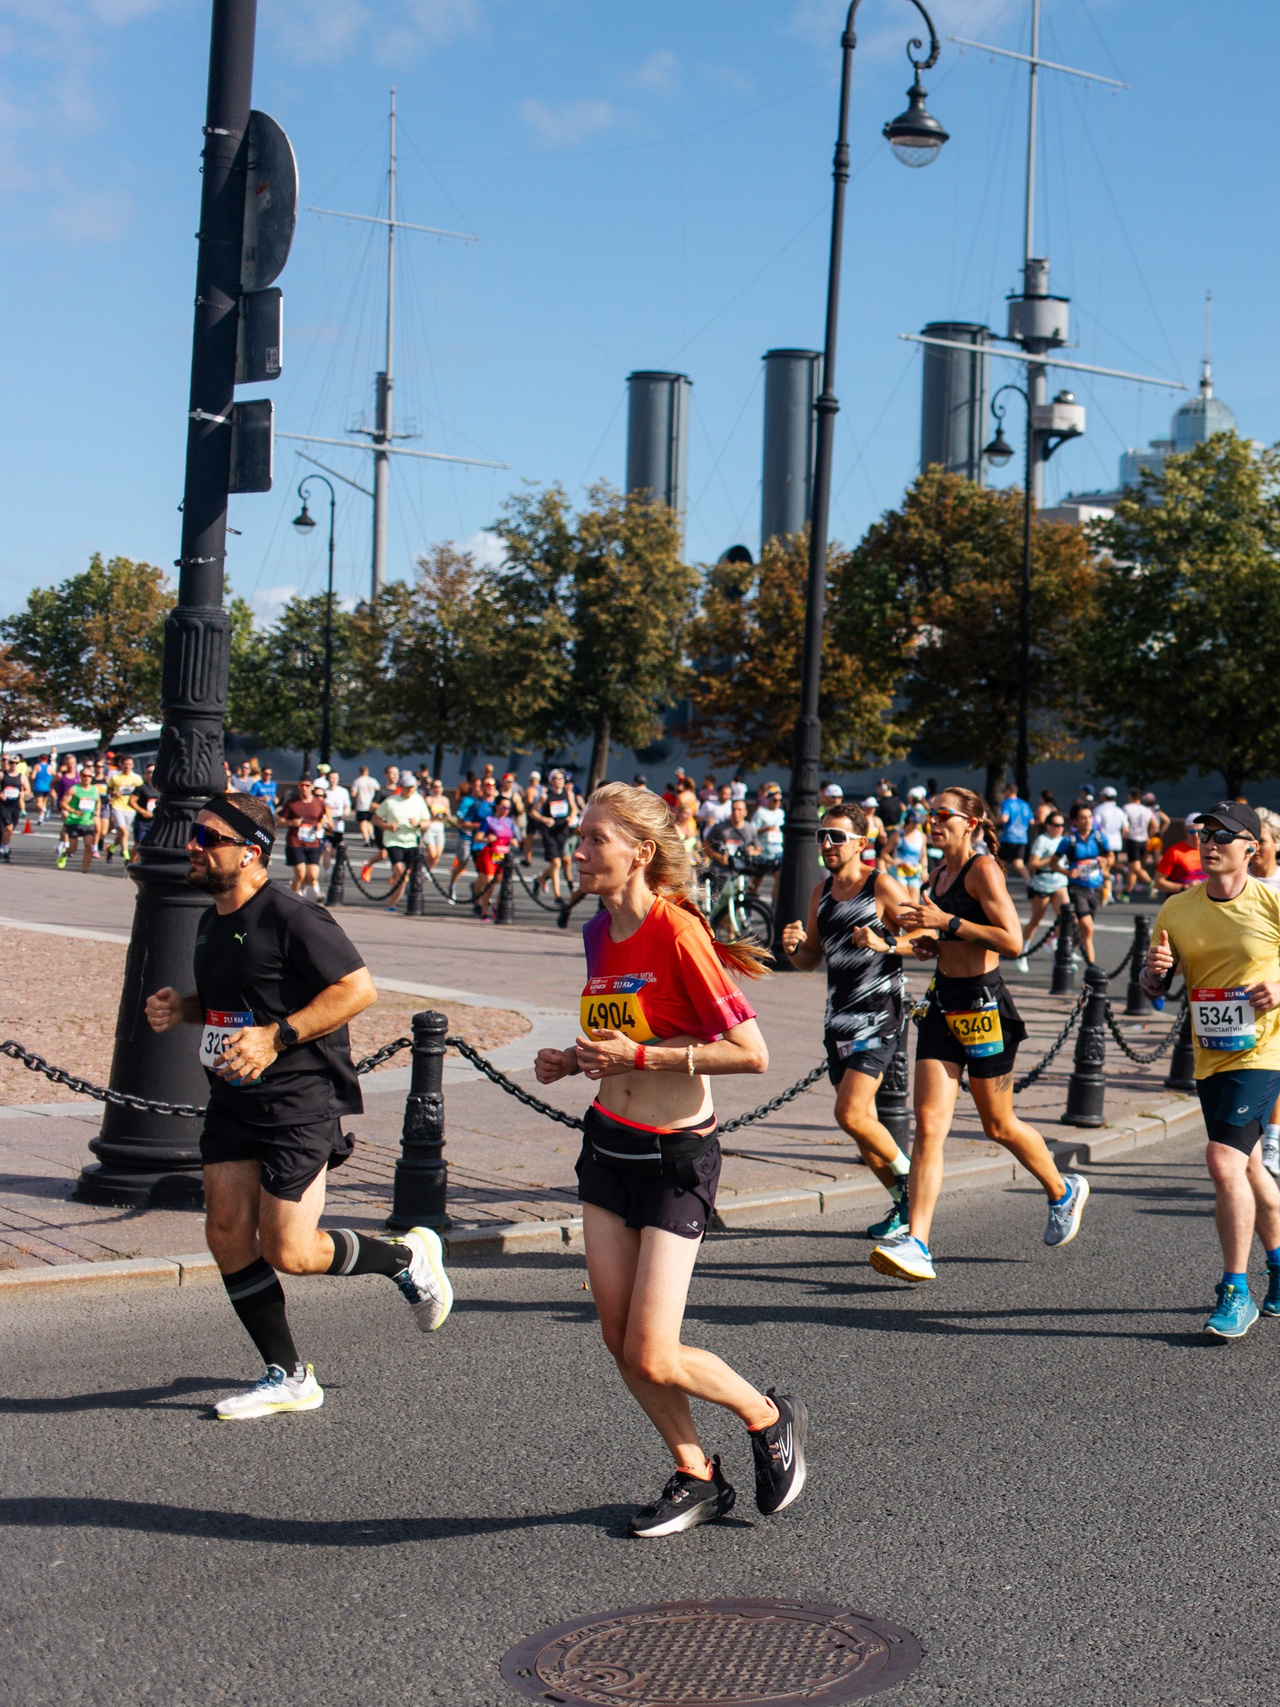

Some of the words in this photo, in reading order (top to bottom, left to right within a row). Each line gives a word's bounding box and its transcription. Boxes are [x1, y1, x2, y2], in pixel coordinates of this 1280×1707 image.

[587, 1001, 636, 1029] 4904
[1198, 1005, 1244, 1026] 5341
[953, 1016, 993, 1036] 6340
[1201, 1037, 1209, 1047] D
